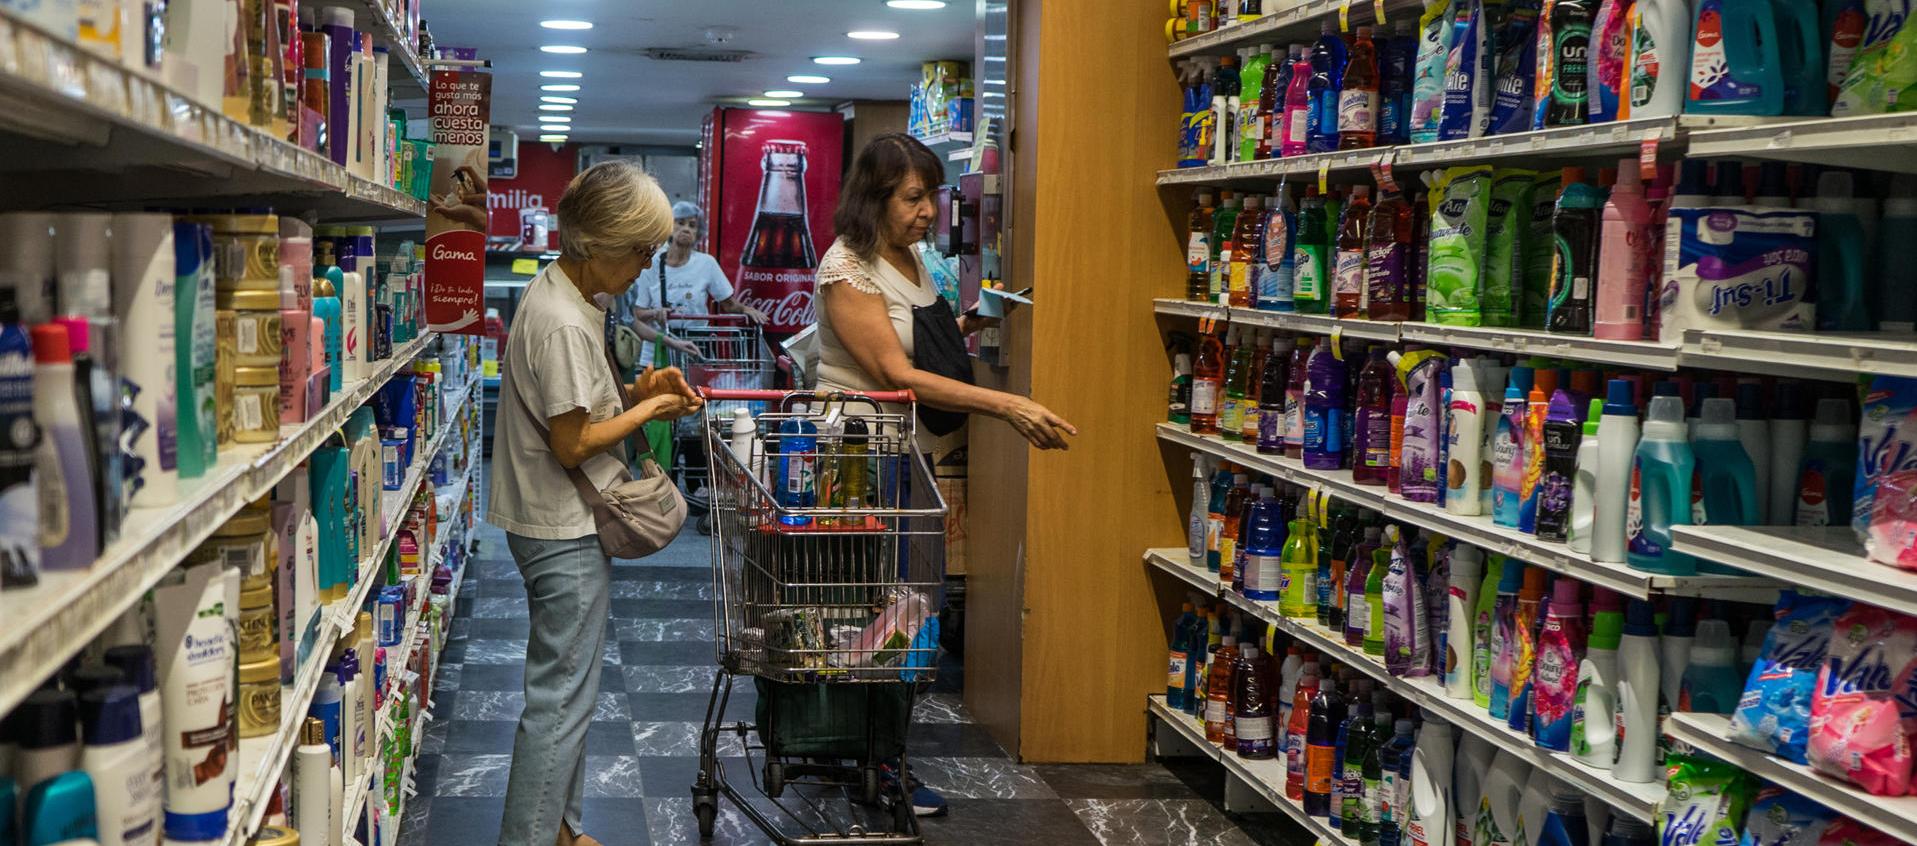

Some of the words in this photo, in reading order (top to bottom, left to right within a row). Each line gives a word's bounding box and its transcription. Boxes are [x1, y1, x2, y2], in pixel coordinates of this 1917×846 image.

[435, 81, 448, 90] Lo
[449, 83, 467, 92] que
[469, 82, 480, 91] te
[435, 92, 460, 100] gusta
[463, 92, 482, 100] más
[434, 102, 479, 115] ahora
[434, 118, 483, 130] cuesta
[434, 132, 483, 144] menos
[432, 244, 478, 261] Gama
[744, 271, 773, 281] SABOR
[775, 274, 817, 282] ORIGINAL
[432, 294, 478, 305] siempre!
